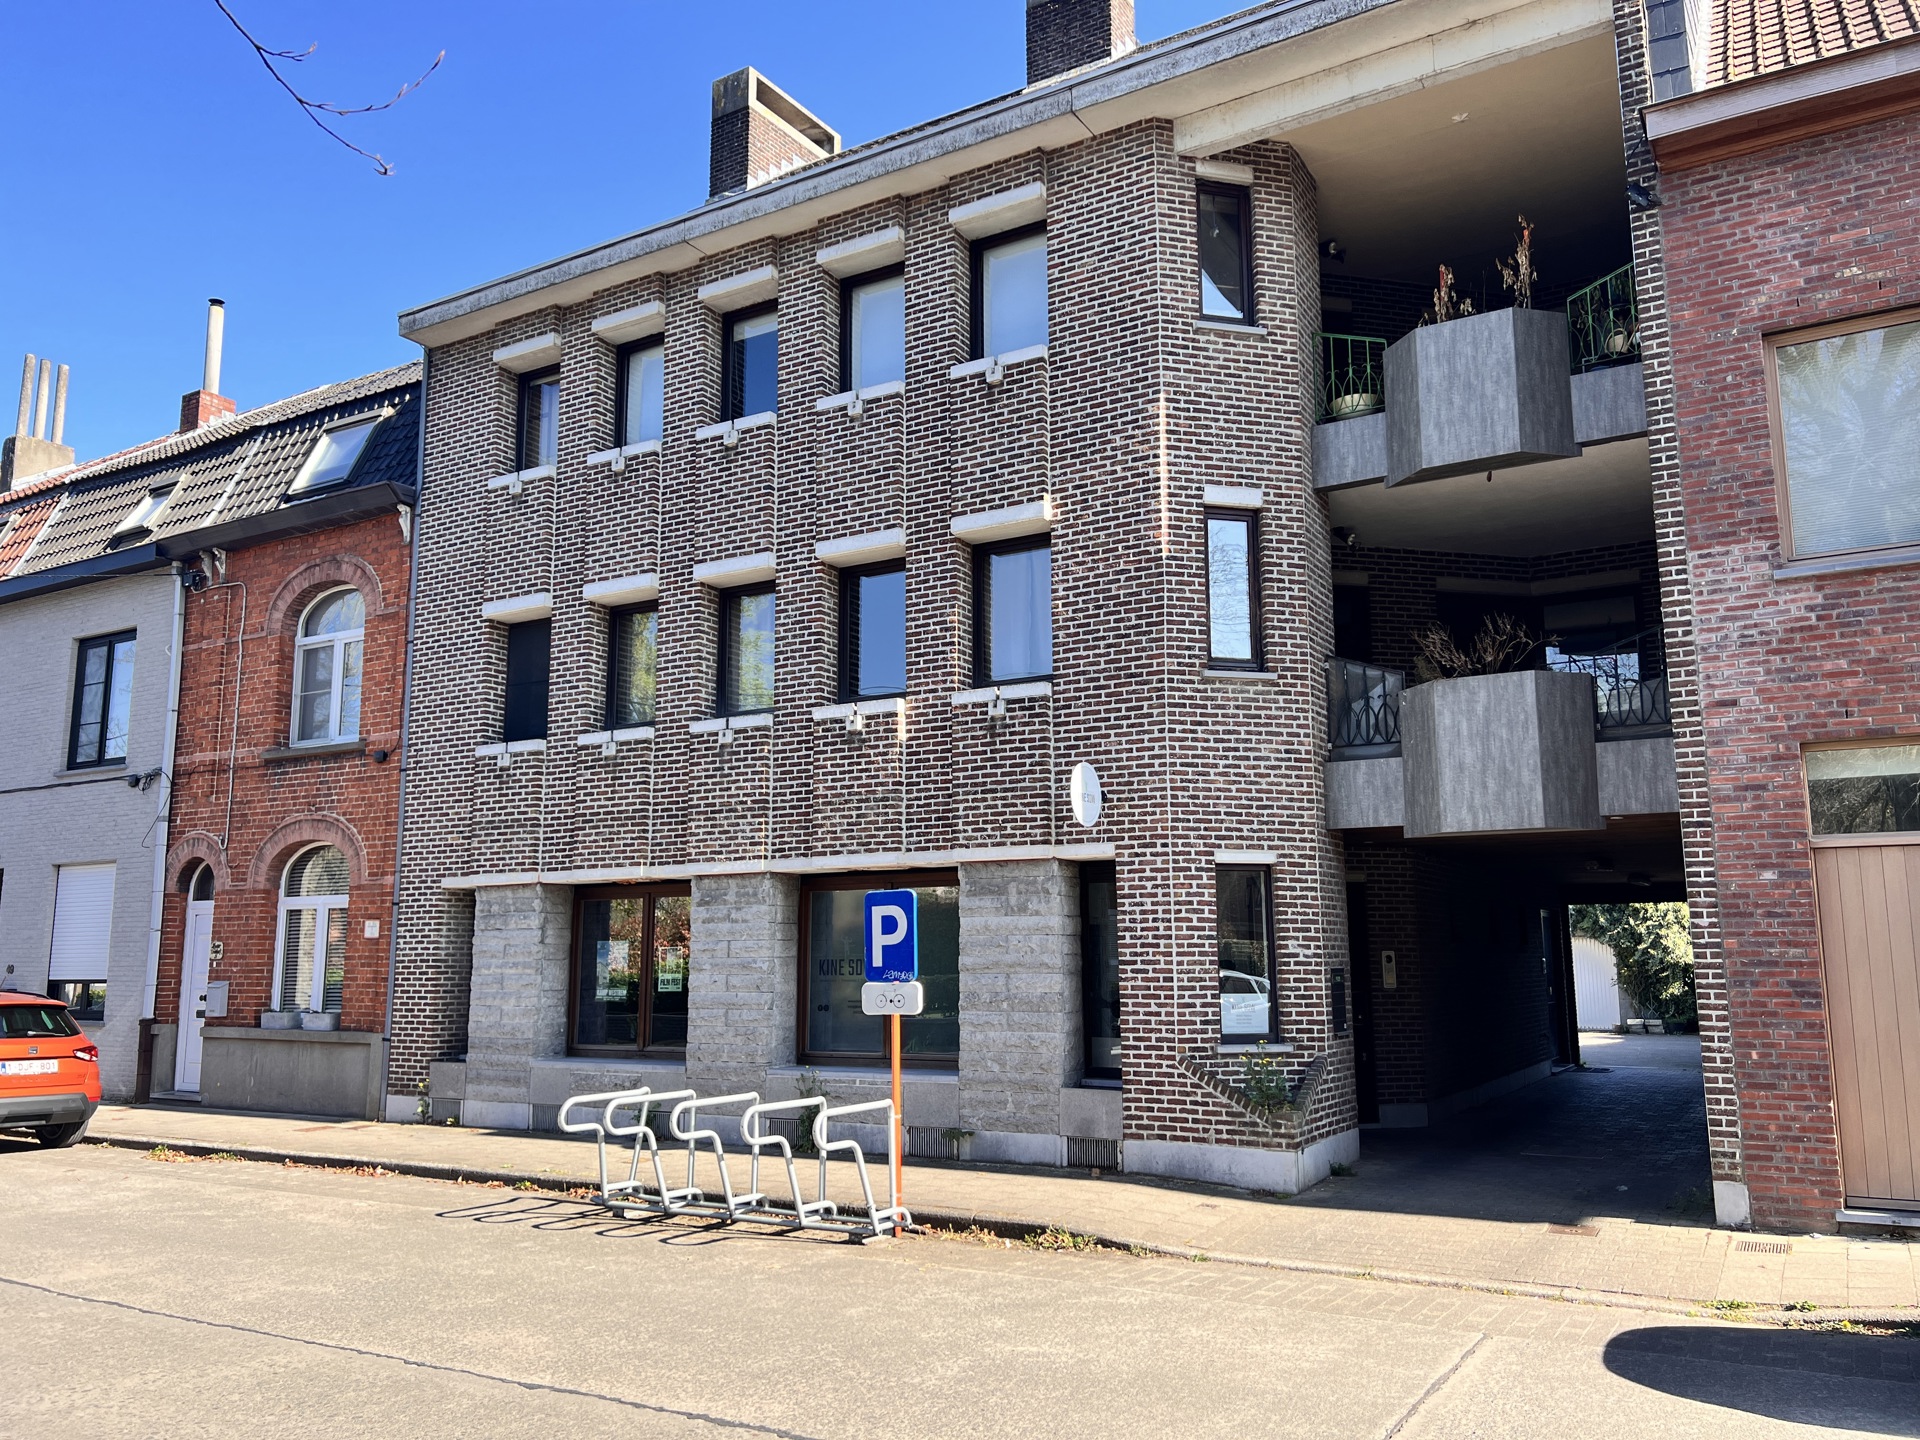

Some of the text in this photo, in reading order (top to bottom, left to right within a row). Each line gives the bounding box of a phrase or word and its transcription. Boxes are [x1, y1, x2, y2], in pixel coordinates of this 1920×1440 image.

[871, 905, 908, 967] P
[819, 959, 845, 976] KINE
[660, 978, 681, 986] FILM FEST
